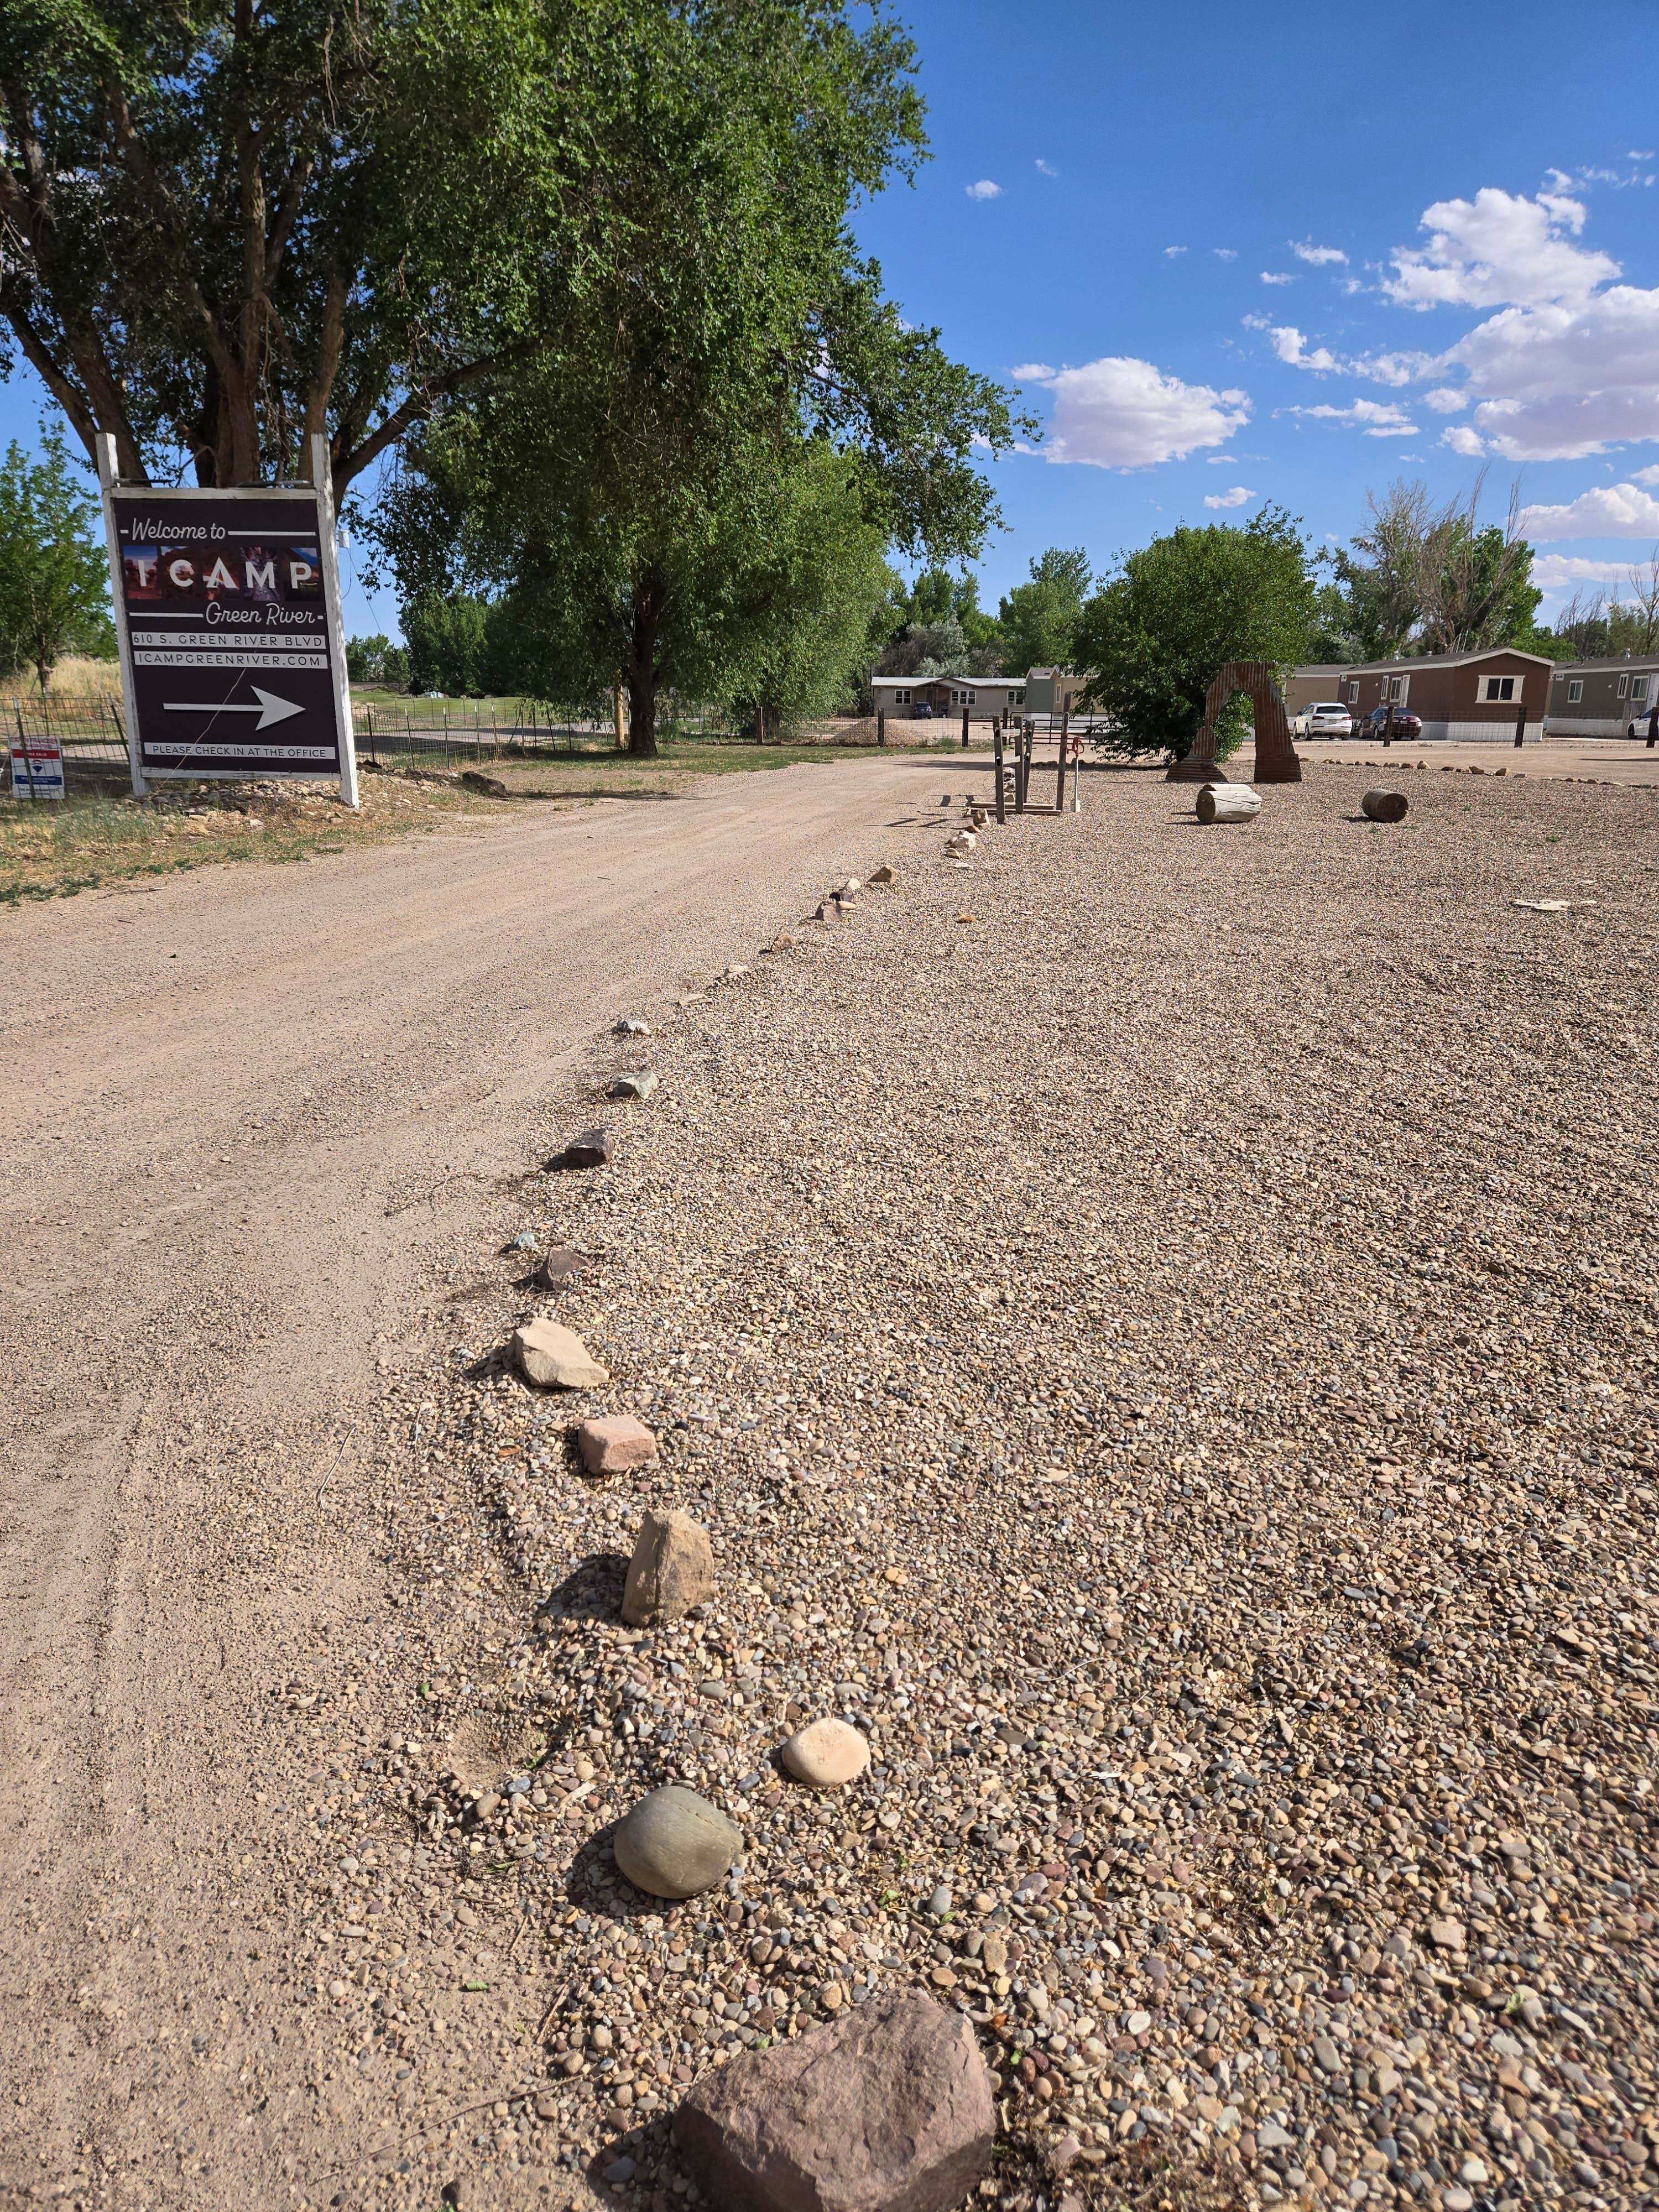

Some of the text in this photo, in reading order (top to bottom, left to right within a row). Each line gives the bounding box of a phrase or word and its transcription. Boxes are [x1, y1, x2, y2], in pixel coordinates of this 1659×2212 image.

[132, 518, 226, 540] Welcome to
[206, 602, 315, 625] Green River
[134, 634, 322, 646] 610 S. GREEN RIVER BLVD
[139, 653, 320, 666] ICAMPGREENRIVER.COM
[153, 745, 326, 758] PLEASE CHECK IN AT THE OFFICE
